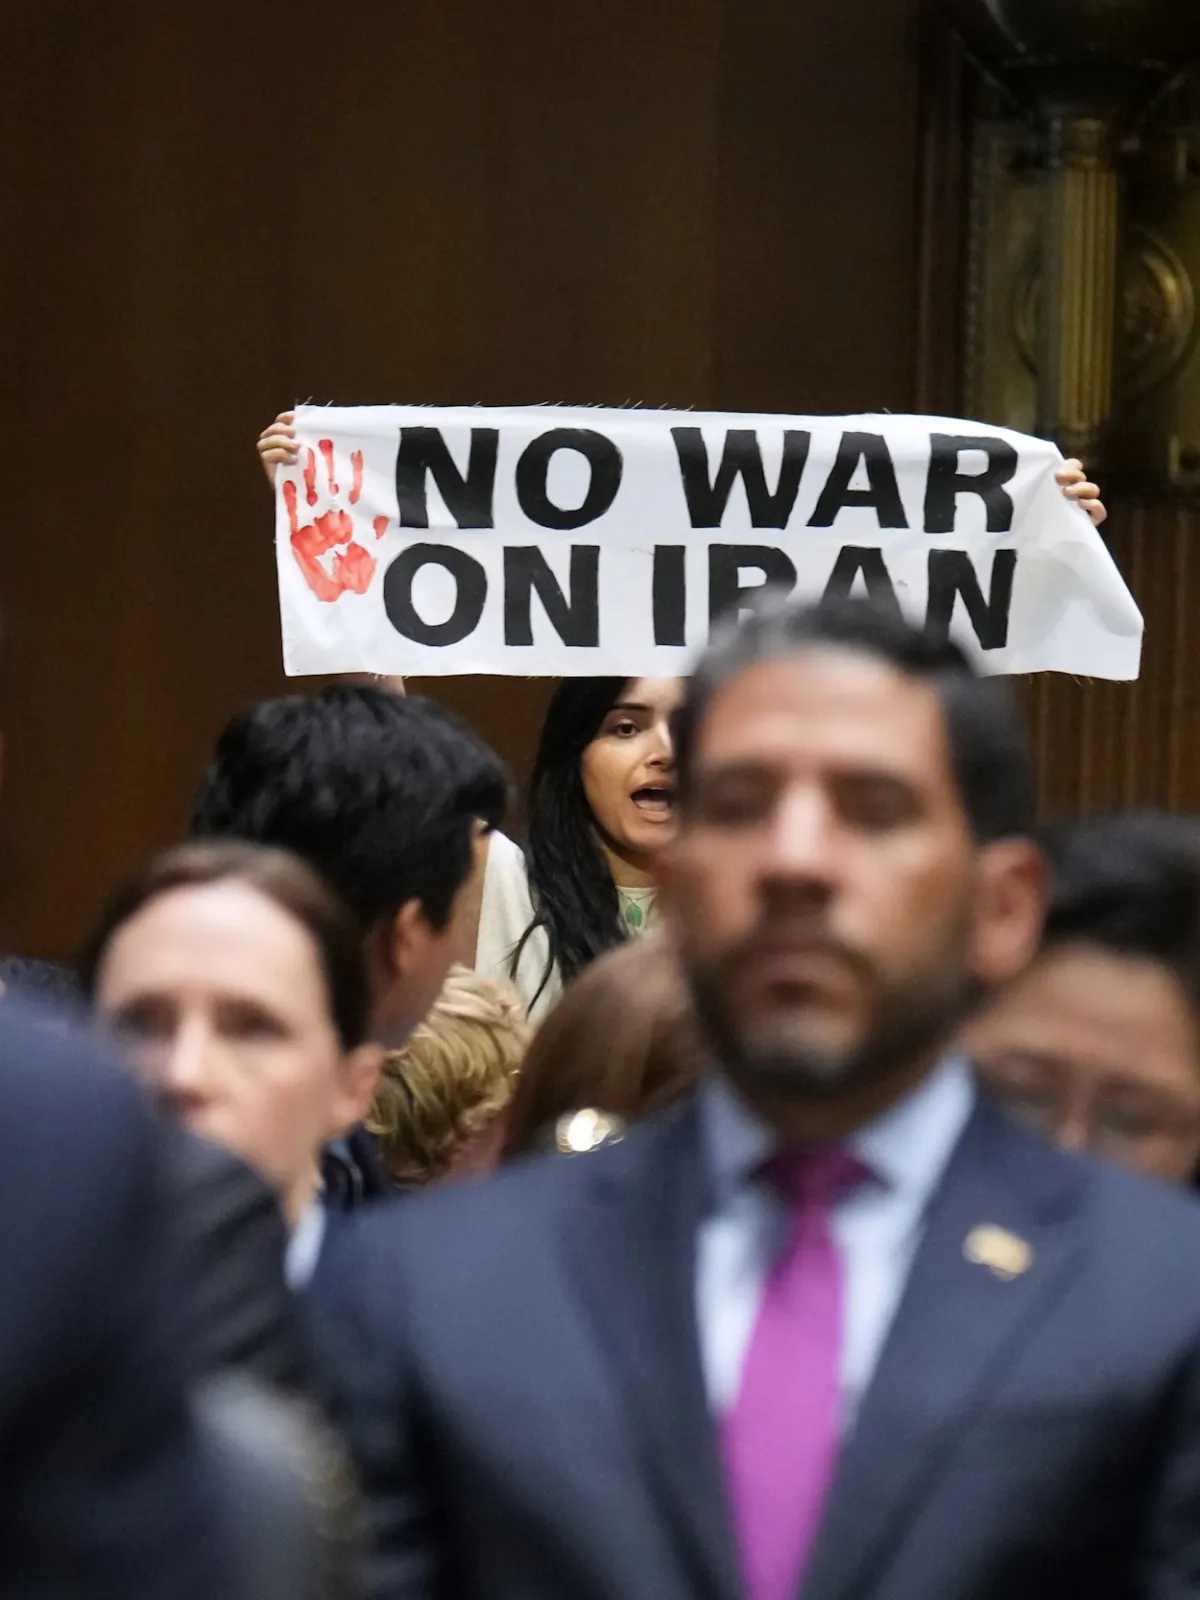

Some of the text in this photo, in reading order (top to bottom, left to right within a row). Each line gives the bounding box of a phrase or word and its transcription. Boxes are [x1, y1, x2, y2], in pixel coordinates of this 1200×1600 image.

[395, 426, 1019, 534] NO WAR
[383, 542, 601, 648] ON
